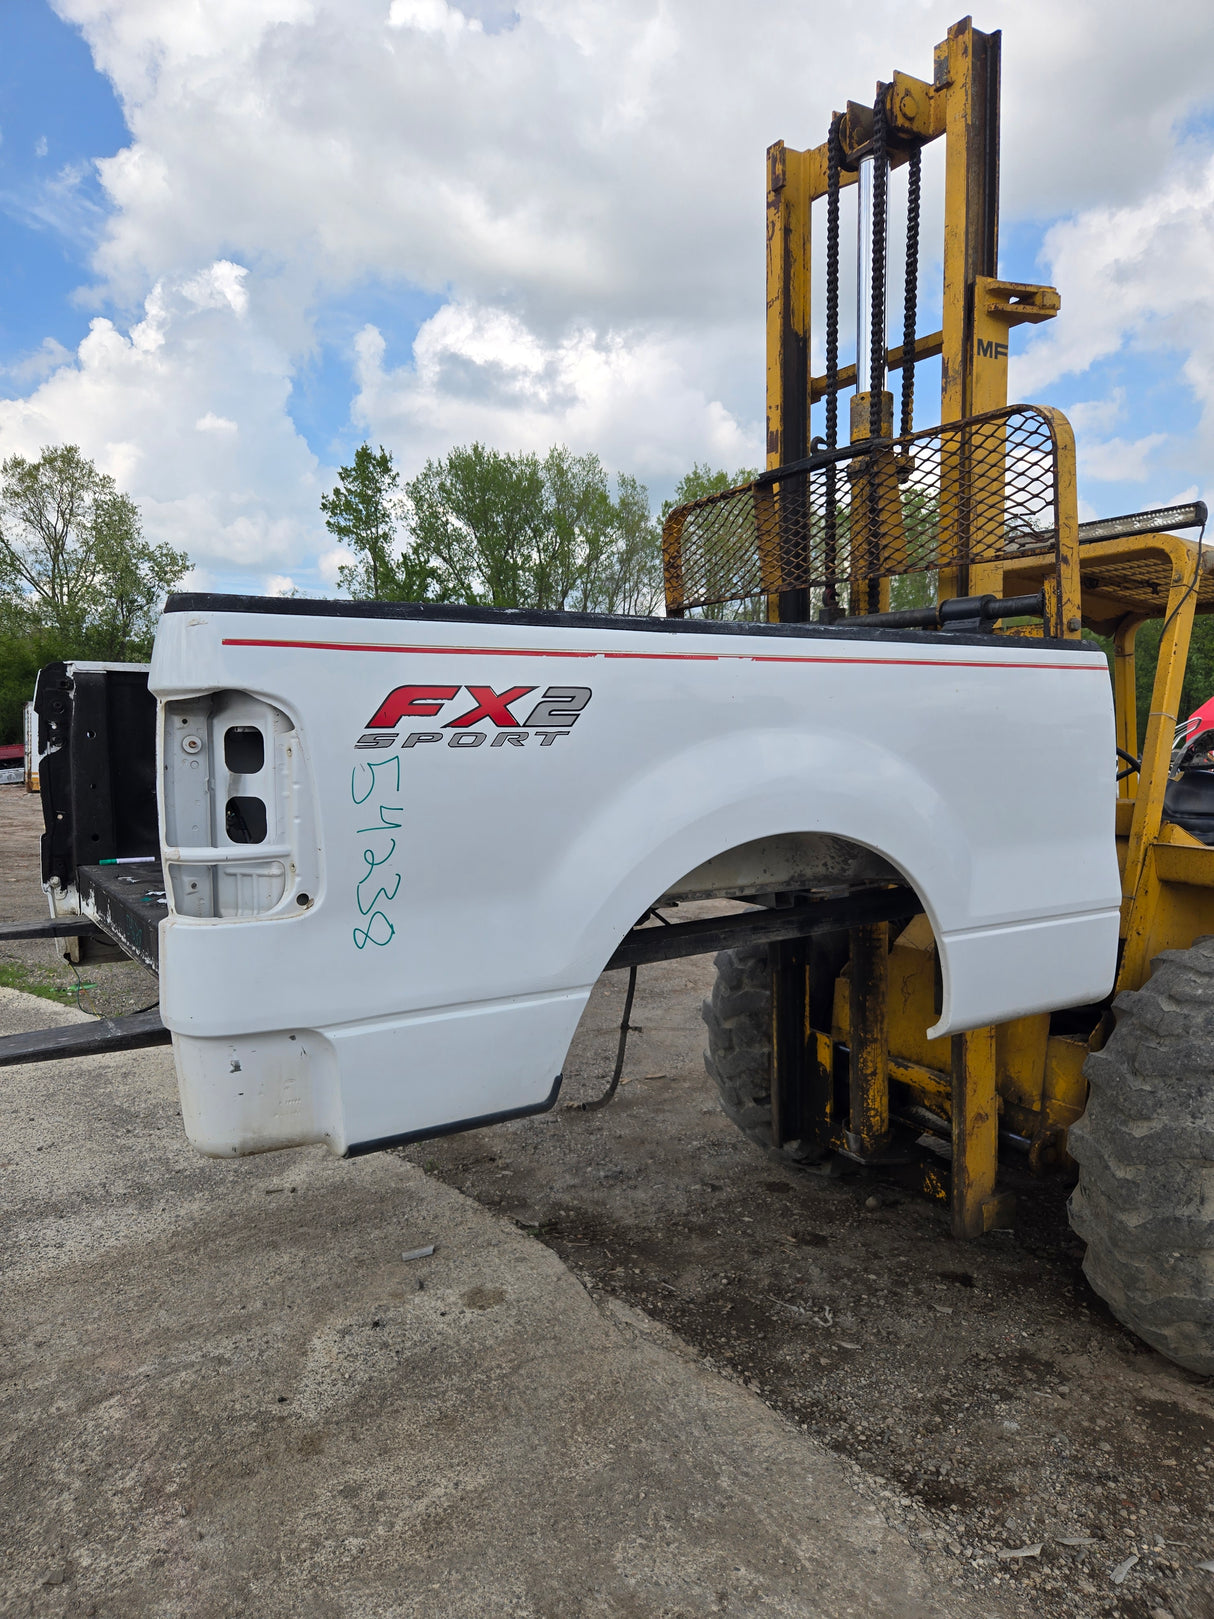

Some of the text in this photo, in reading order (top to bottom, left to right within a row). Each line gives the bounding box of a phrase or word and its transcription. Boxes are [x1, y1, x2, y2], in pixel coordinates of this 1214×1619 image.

[978, 338, 1008, 359] MF
[365, 685, 592, 729] FX2
[354, 731, 570, 749] SPORT
[352, 756, 403, 949] 54238
